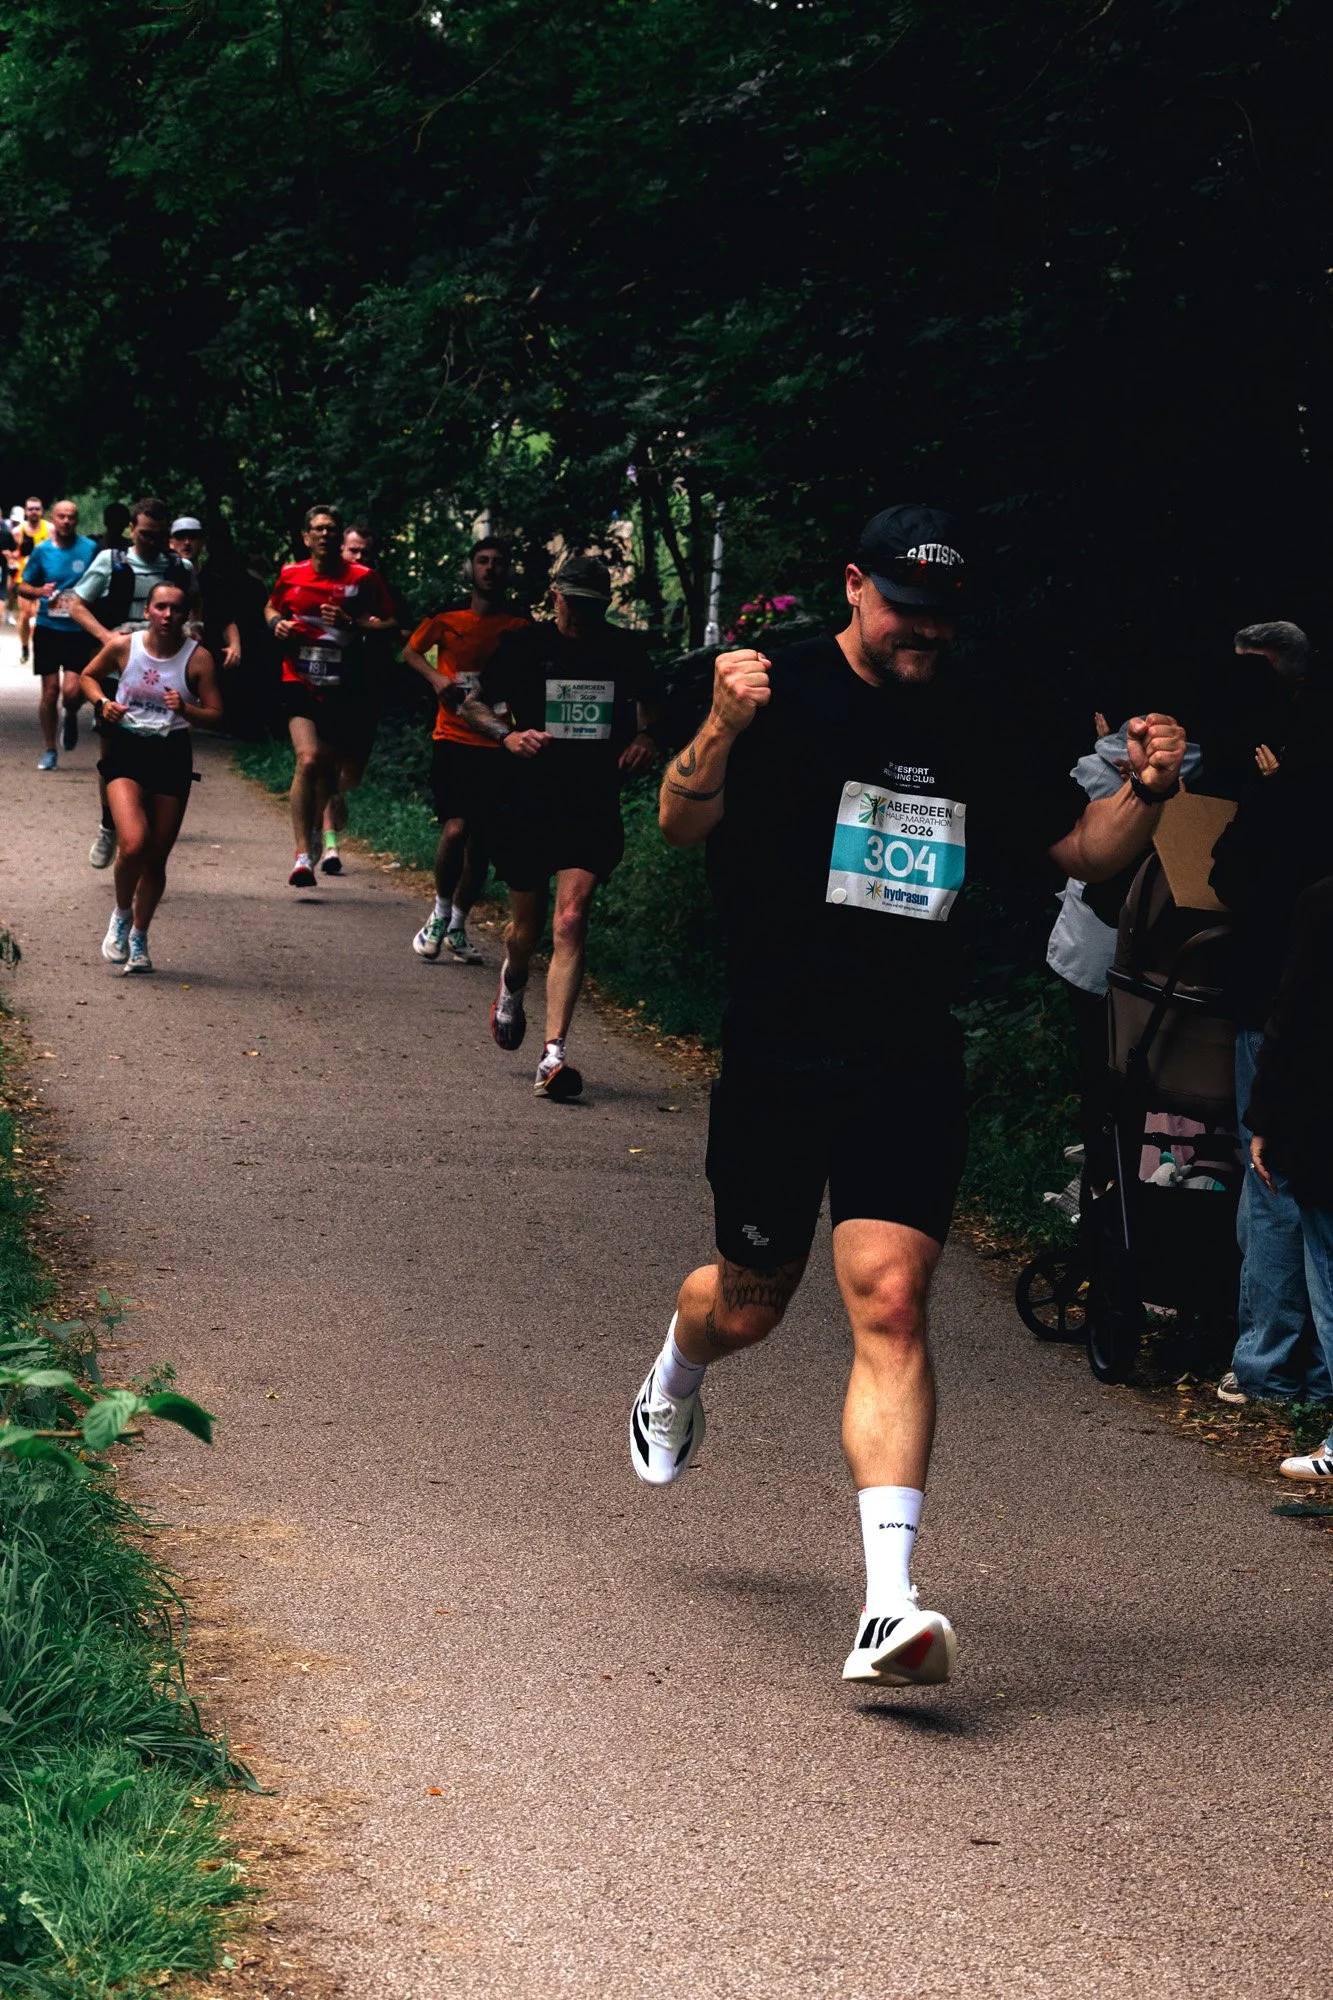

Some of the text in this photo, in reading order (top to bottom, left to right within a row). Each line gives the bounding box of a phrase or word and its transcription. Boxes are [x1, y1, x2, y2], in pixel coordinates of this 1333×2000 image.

[561, 703, 600, 722] 1150
[912, 775, 936, 784] CLUB
[887, 800, 953, 819] ABERDEEN
[885, 811, 953, 828] HALF MARATHON
[900, 823, 934, 837] 2026
[863, 835, 937, 883] 304
[883, 886, 929, 906] hydrasun
